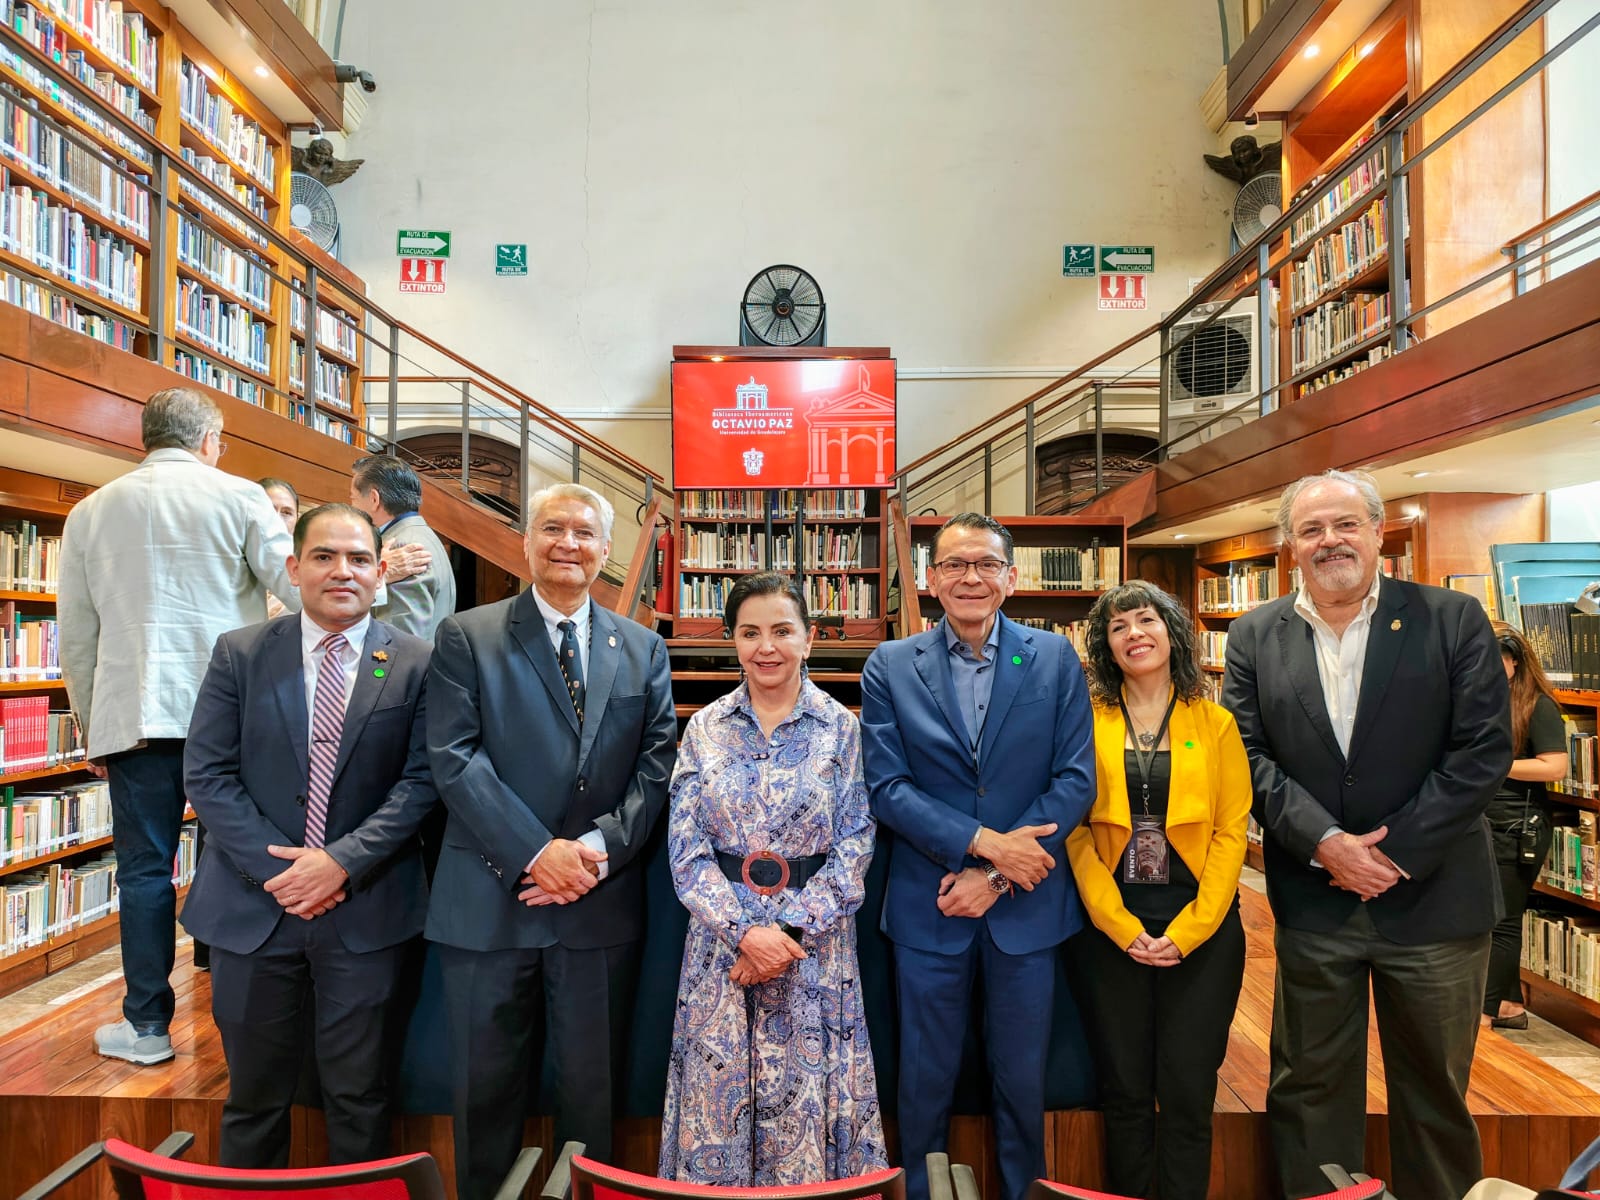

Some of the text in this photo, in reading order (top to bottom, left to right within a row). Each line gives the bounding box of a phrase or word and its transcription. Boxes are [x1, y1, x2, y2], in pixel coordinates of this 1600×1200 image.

[400, 284, 444, 292] EXTINTOR
[1100, 300, 1145, 308] EXTINTOR
[712, 418, 793, 429] OCTAVIO PAZ
